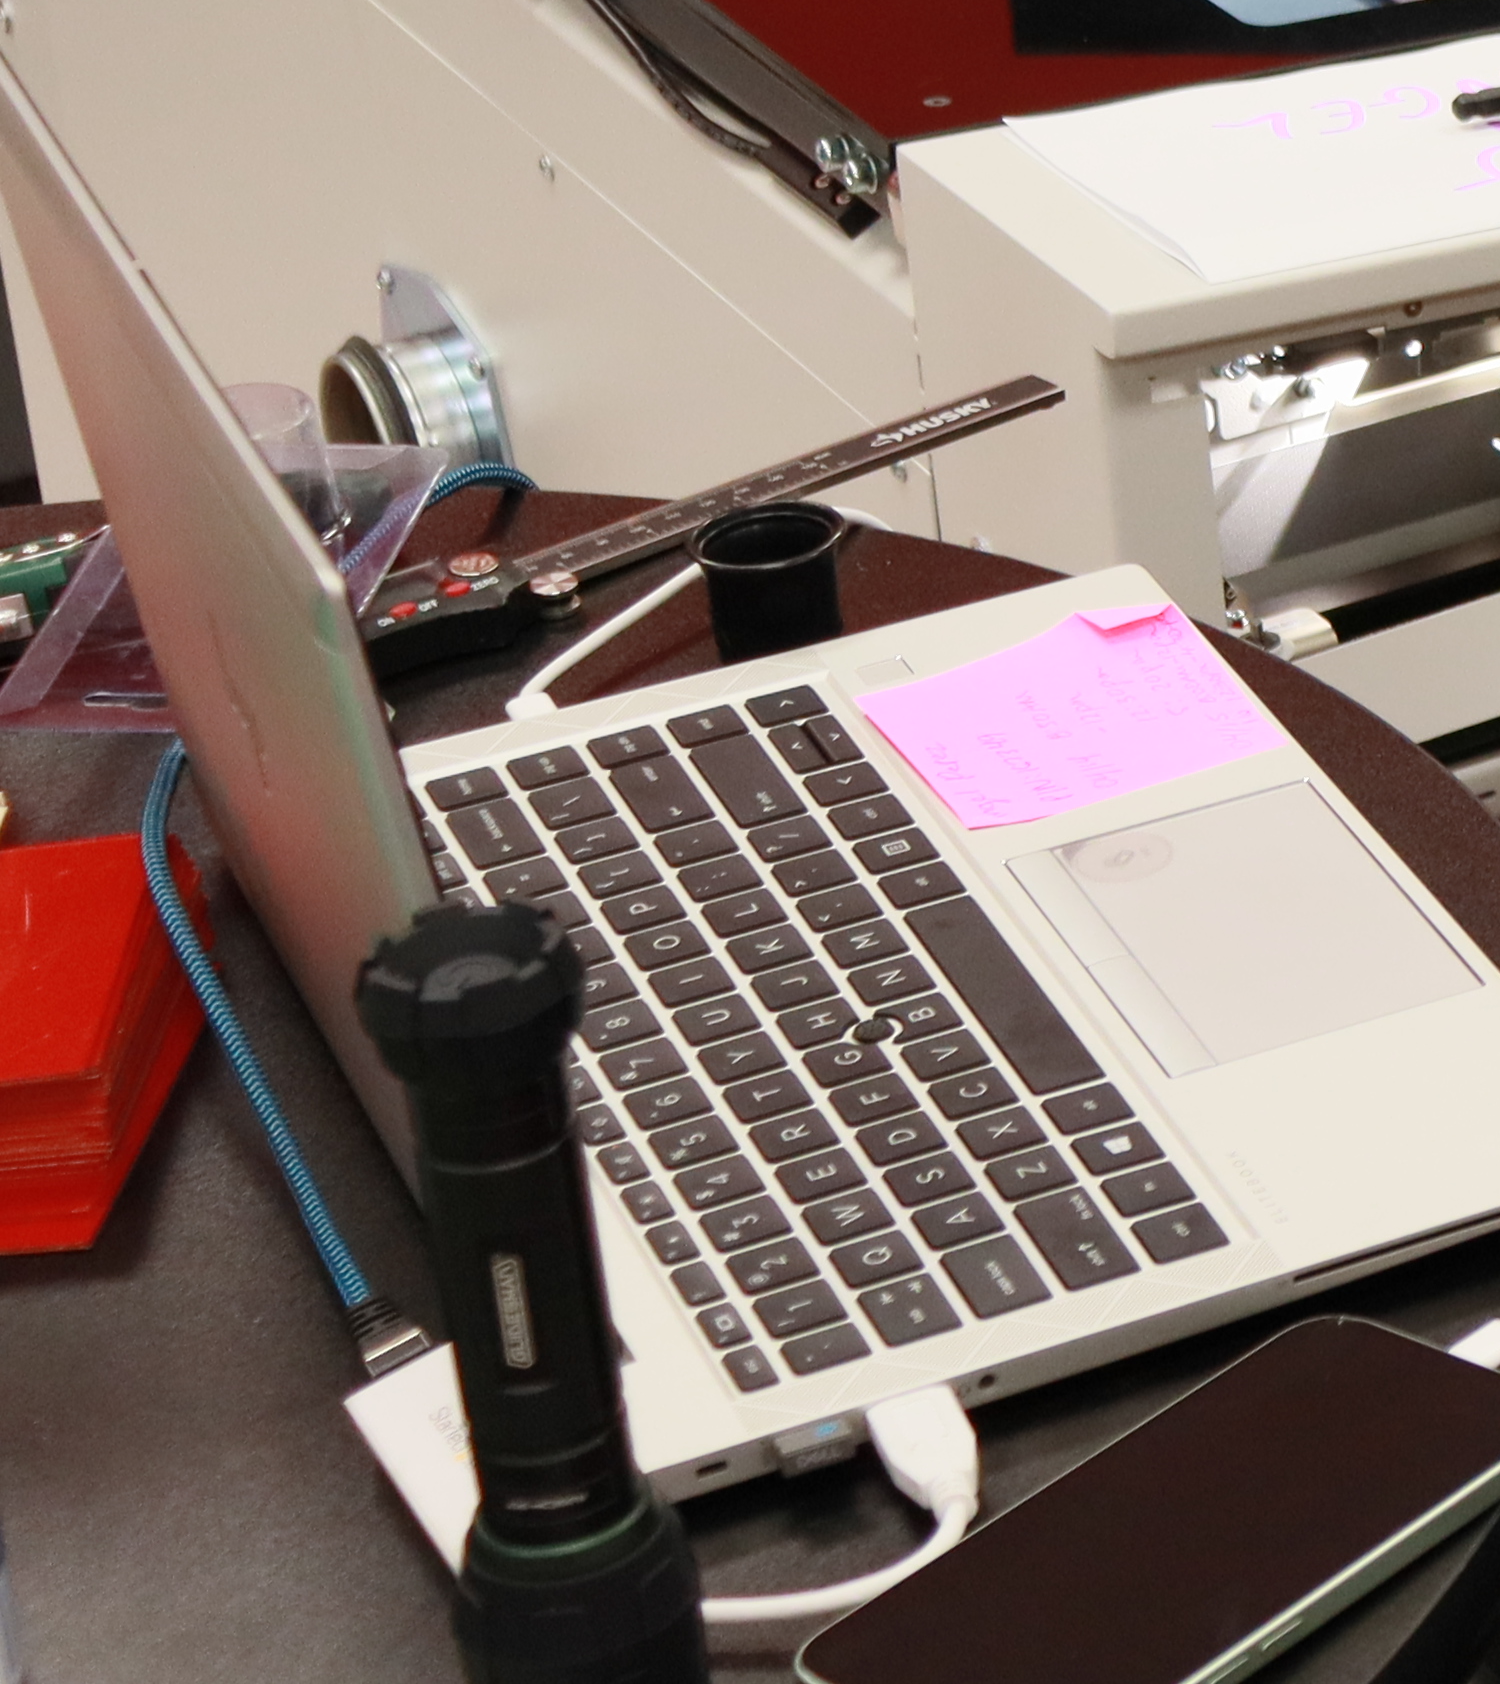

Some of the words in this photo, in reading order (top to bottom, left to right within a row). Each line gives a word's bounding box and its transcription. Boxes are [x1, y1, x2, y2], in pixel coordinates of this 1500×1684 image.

[899, 397, 993, 437] HUSKY
[629, 902, 657, 915] P
[734, 902, 759, 918] L
[652, 935, 681, 950] O
[755, 938, 784, 955] K
[850, 932, 880, 950] M
[679, 974, 704, 985] I
[780, 976, 808, 986] J
[876, 969, 906, 987] N
[605, 1016, 630, 1029] 8
[701, 1008, 731, 1026] U
[806, 1011, 837, 1029] H
[907, 1006, 936, 1023] B
[727, 1050, 754, 1065] Y
[833, 1049, 862, 1066] G
[931, 1046, 959, 1062] V
[628, 1058, 654, 1069] 7
[752, 1088, 781, 1102] T
[959, 1082, 988, 1098] C
[655, 1093, 681, 1107] 6
[859, 1092, 890, 1105] F
[780, 1123, 810, 1142] R
[887, 1128, 917, 1146] D
[988, 1120, 1017, 1139] X
[679, 1132, 707, 1147] 5
[805, 1164, 837, 1182] E
[915, 1168, 945, 1184] S
[1015, 1160, 1047, 1179] Z
[706, 1172, 730, 1184] 4
[1069, 1193, 1089, 1212] lock
[731, 1213, 759, 1229] 3
[831, 1204, 864, 1227] W
[945, 1207, 975, 1224] A
[760, 1254, 787, 1270] 2
[862, 1245, 892, 1265] Q
[985, 1260, 1004, 1280] lock
[787, 1299, 812, 1312] 1
